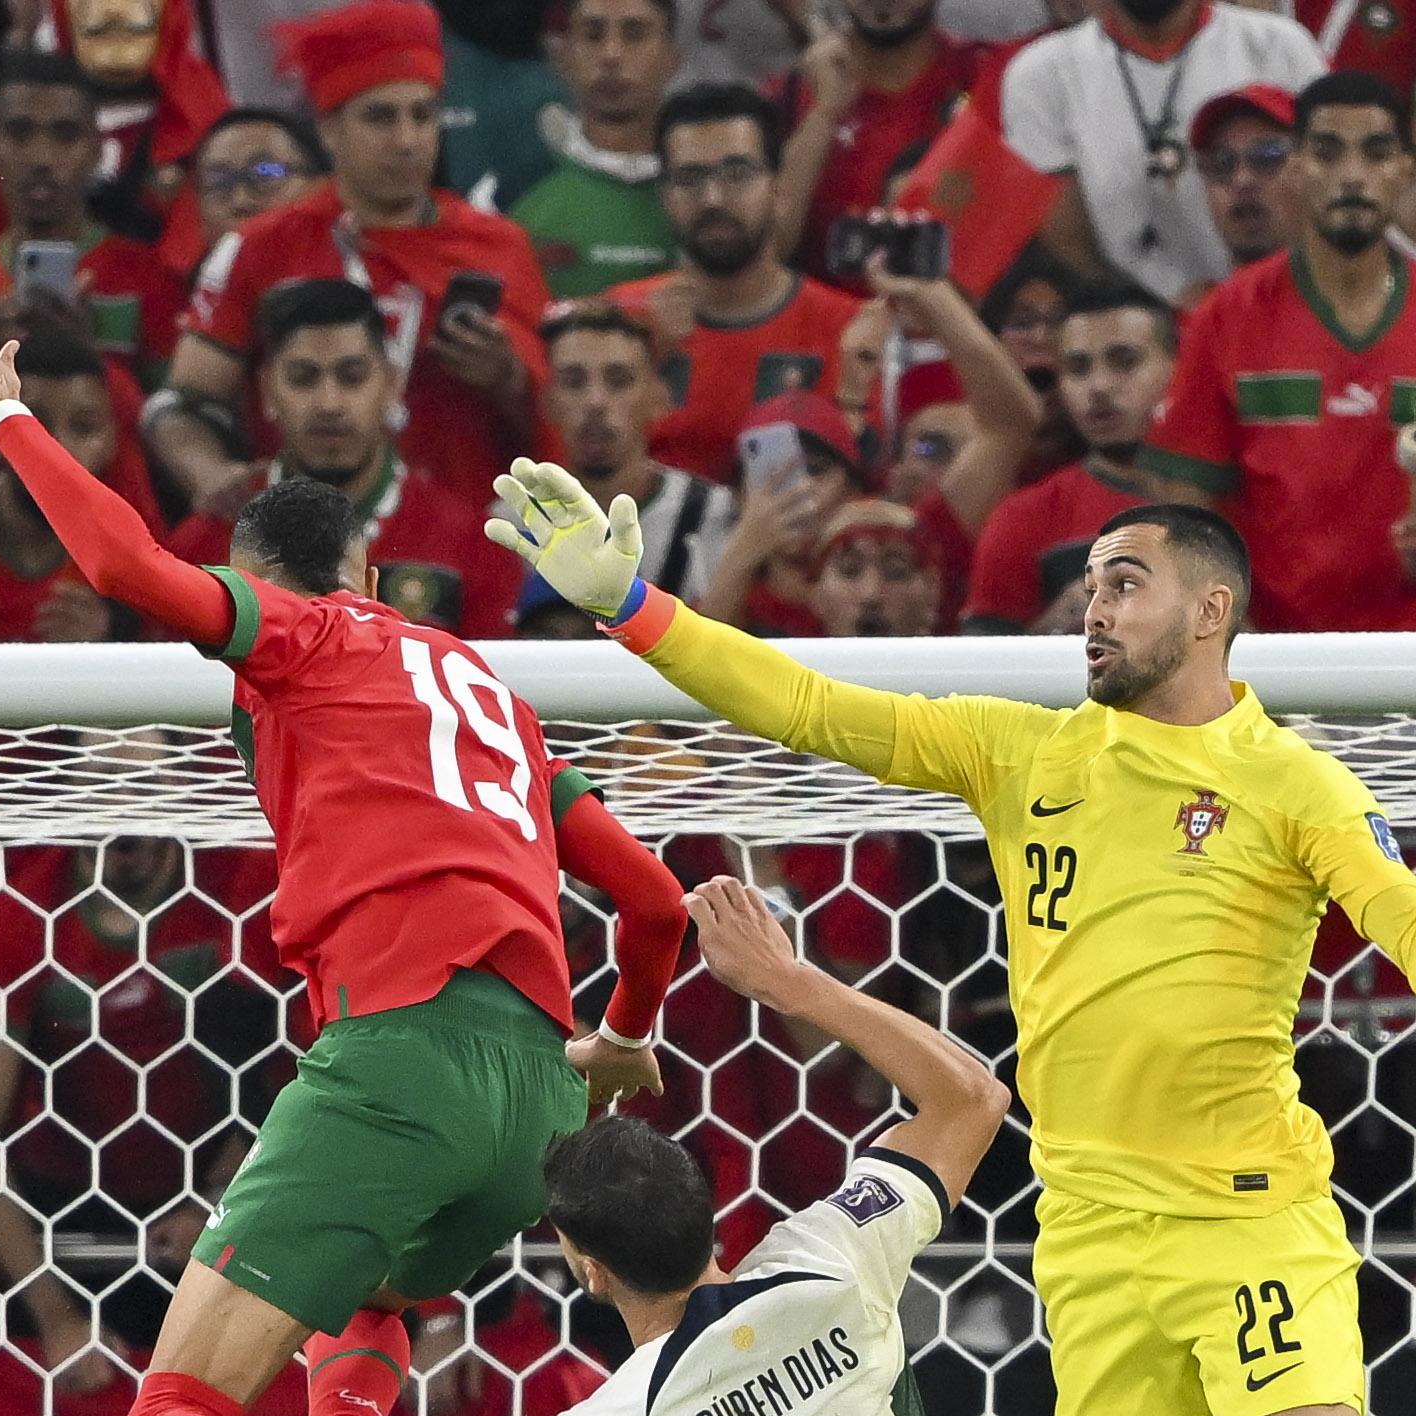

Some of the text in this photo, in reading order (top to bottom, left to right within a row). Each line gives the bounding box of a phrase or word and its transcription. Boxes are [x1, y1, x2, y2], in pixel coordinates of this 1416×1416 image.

[400, 636, 537, 842] 19
[1025, 842, 1078, 932] 22
[782, 1327, 859, 1401] DIAS
[1234, 1280, 1302, 1365] 22
